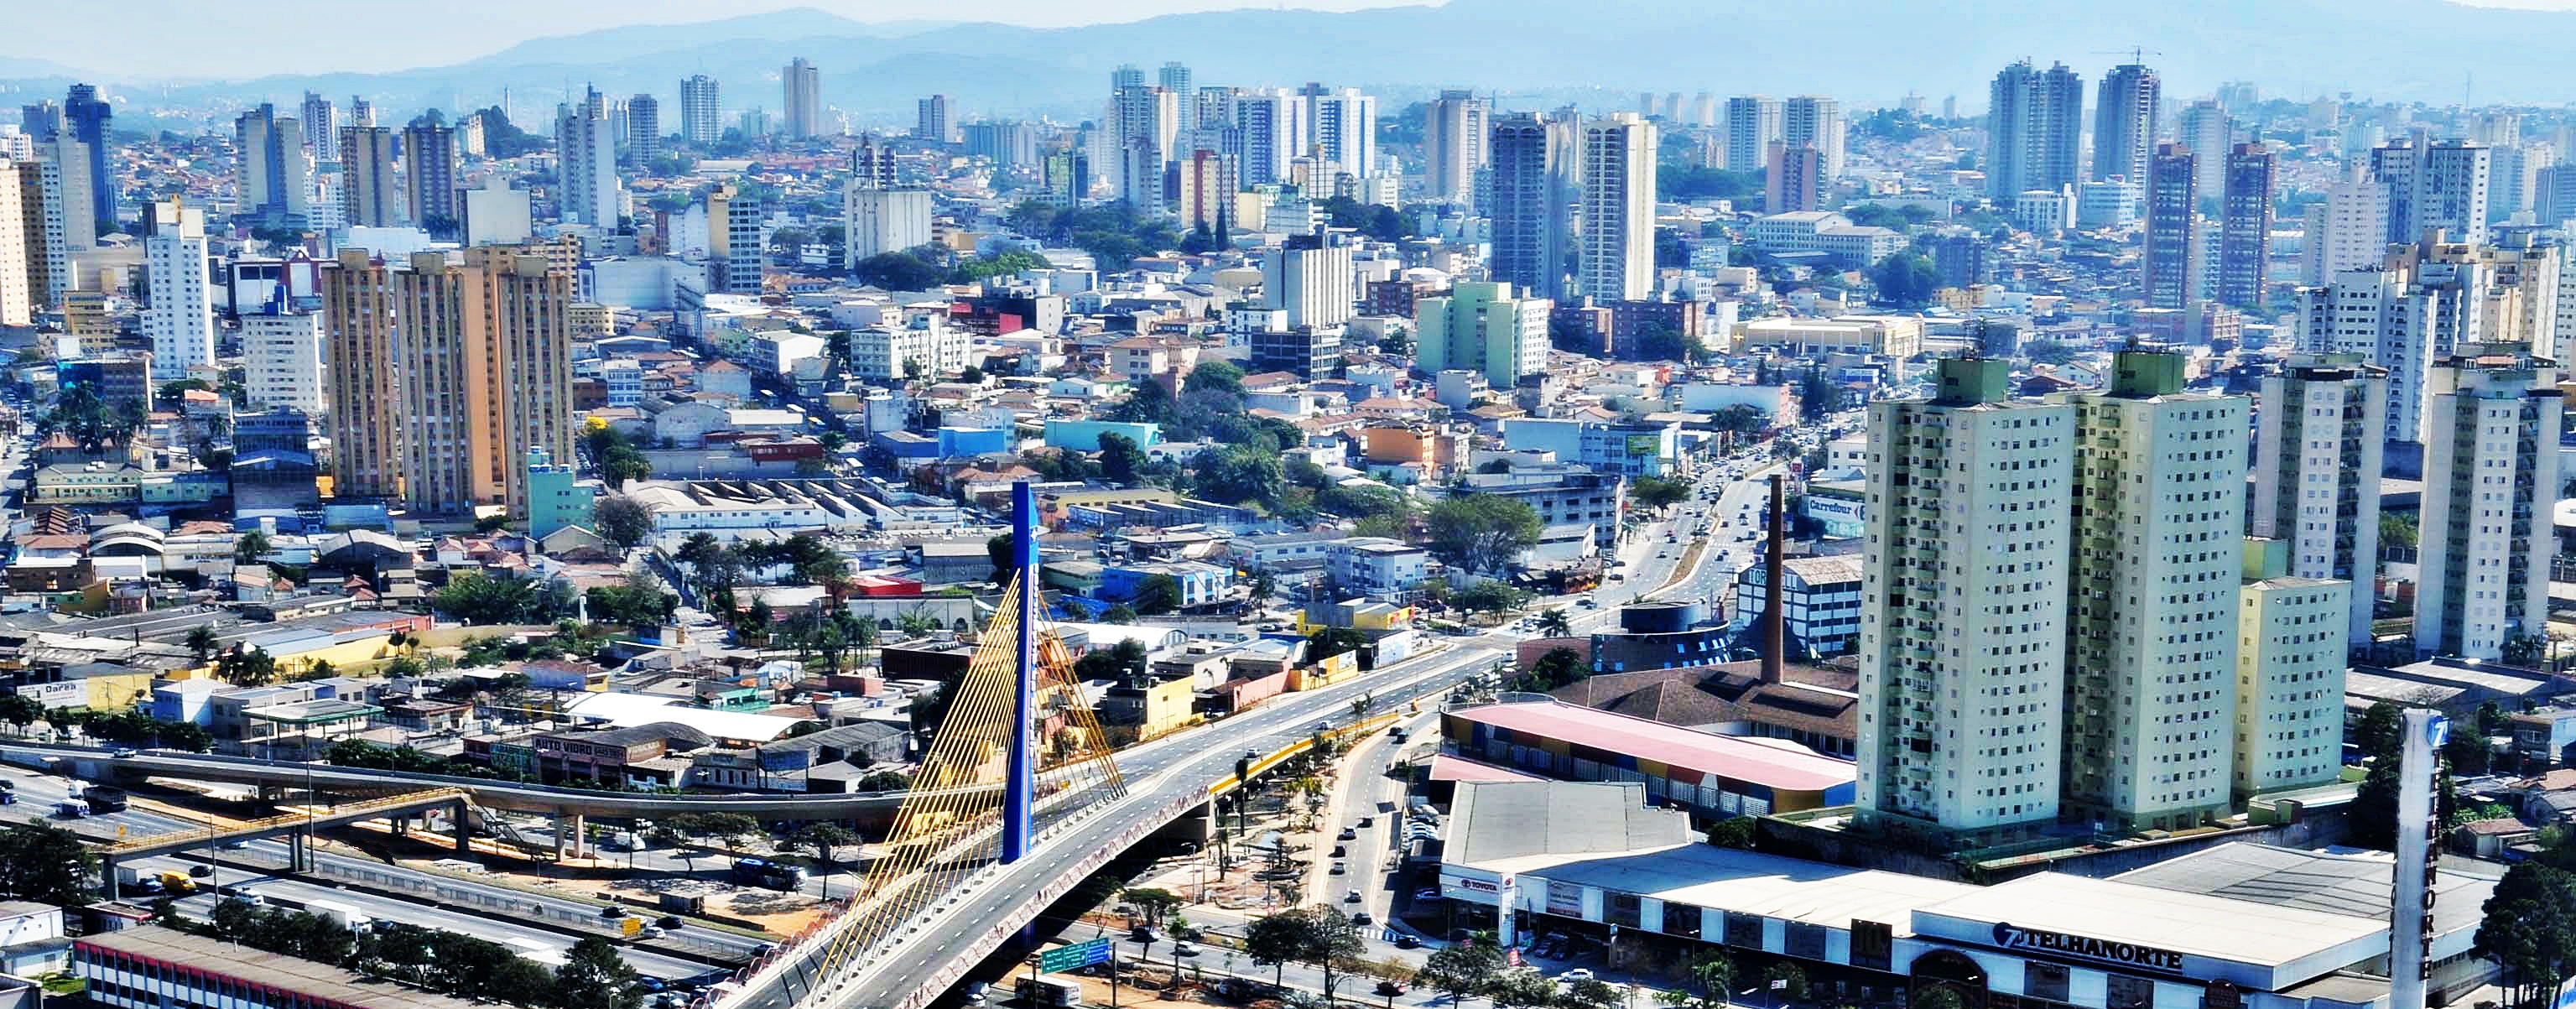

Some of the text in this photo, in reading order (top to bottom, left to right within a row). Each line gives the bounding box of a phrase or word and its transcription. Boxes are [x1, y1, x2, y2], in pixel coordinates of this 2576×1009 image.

[1810, 500, 1851, 514] Carrefour
[537, 739, 559, 752] AUTO
[1471, 882, 1497, 891] TOYOTA
[2023, 929, 2183, 969] TELHANORTE
